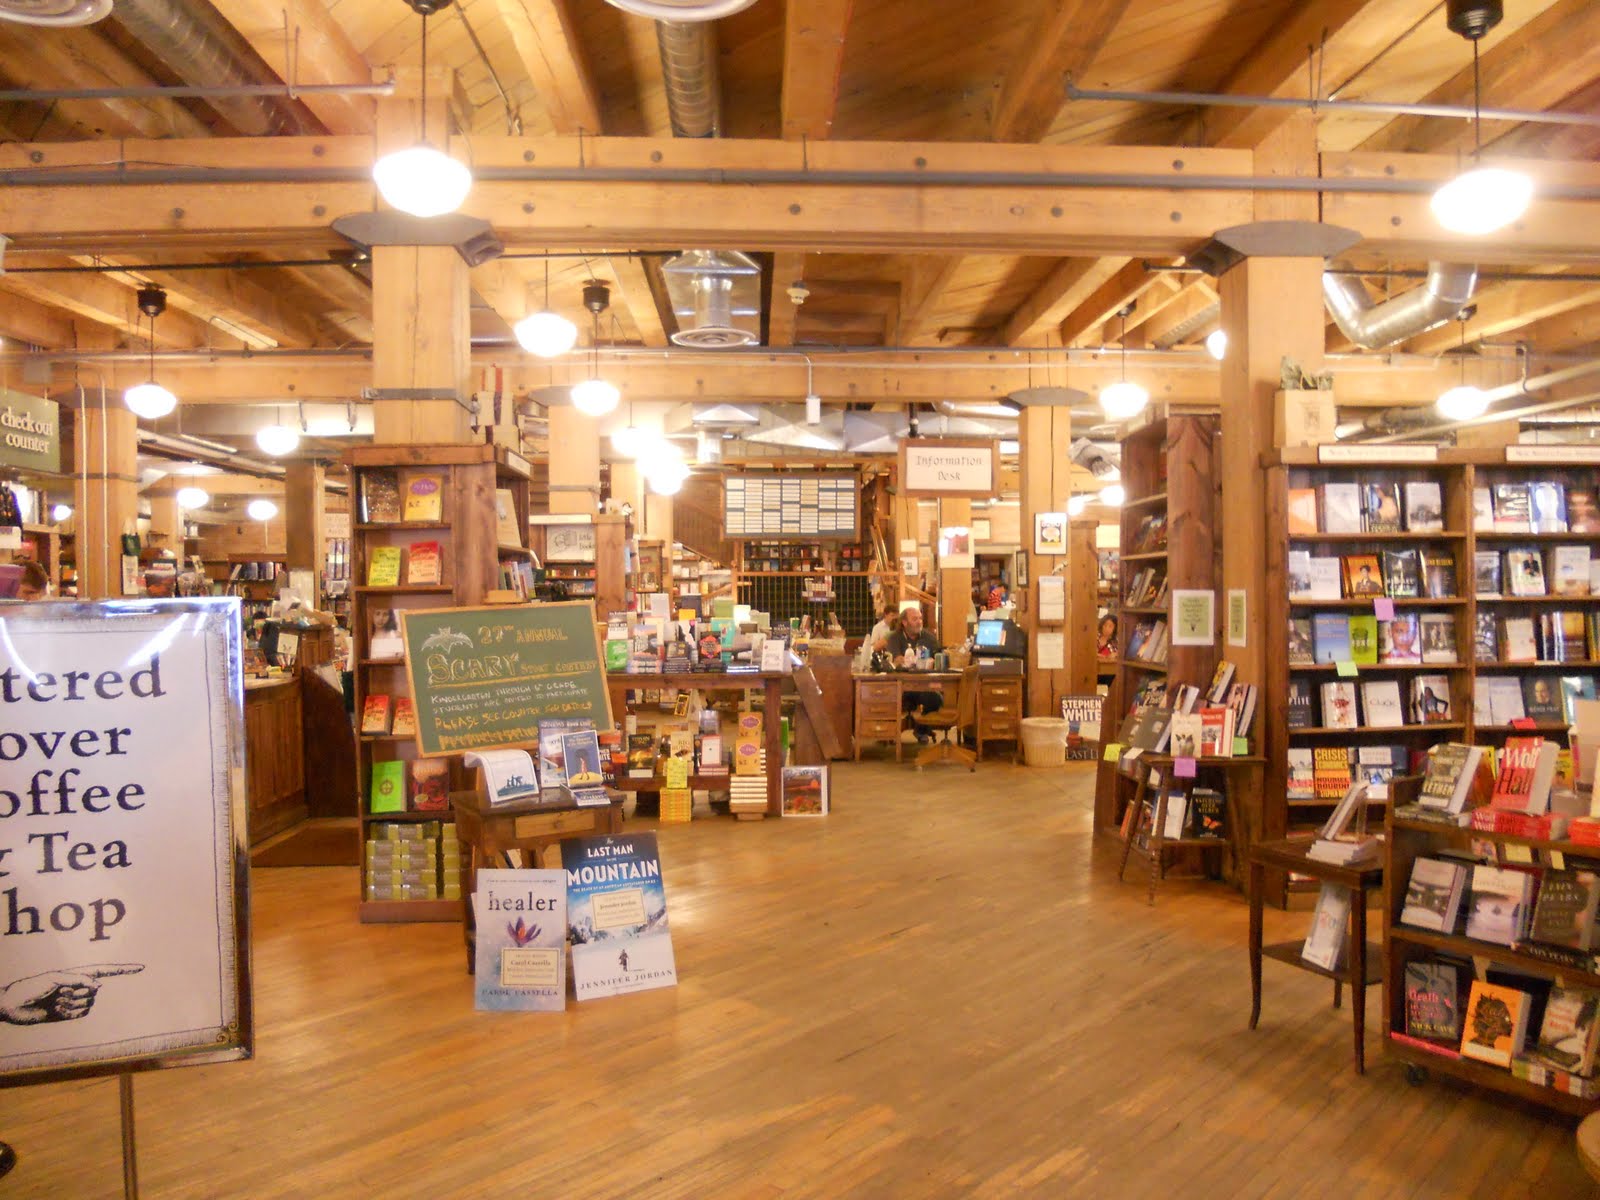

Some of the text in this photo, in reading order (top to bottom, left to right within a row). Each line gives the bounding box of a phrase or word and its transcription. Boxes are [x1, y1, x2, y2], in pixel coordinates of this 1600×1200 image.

[1, 406, 53, 436] check out
[6, 431, 50, 454] counter
[916, 455, 982, 467] Information
[938, 471, 961, 481] Desk
[515, 627, 568, 643] ANNUAL
[0, 652, 166, 702] tered
[426, 652, 519, 686] SCARY
[495, 685, 531, 695] THROUGH
[546, 680, 577, 690] GRADE
[433, 703, 480, 714] STUDENTS
[484, 699, 500, 708] ARE
[504, 695, 532, 704] INVITED
[546, 688, 589, 699] PARTICIPATE
[1062, 699, 1102, 709] STEPHEN
[435, 714, 480, 730] PLEASE
[482, 711, 500, 723] SEE
[502, 708, 540, 720] COUNTER
[1062, 709, 1102, 722] WHITE
[0, 726, 132, 761] over
[1066, 749, 1088, 760] LAST
[1315, 749, 1347, 761] CRISIS
[1505, 748, 1541, 769] Wolf
[1496, 767, 1535, 796] Hall
[0, 768, 146, 818] offee
[28, 831, 132, 873] Tea
[587, 843, 634, 858] LAST MAN
[566, 859, 659, 887] MOUNTAIN
[487, 890, 558, 911] healer
[3, 886, 127, 941] hop
[580, 968, 673, 990] JENNIFER JORDAN
[482, 989, 559, 997] CAROL CASSELLA
[1411, 1022, 1433, 1030] NICK
